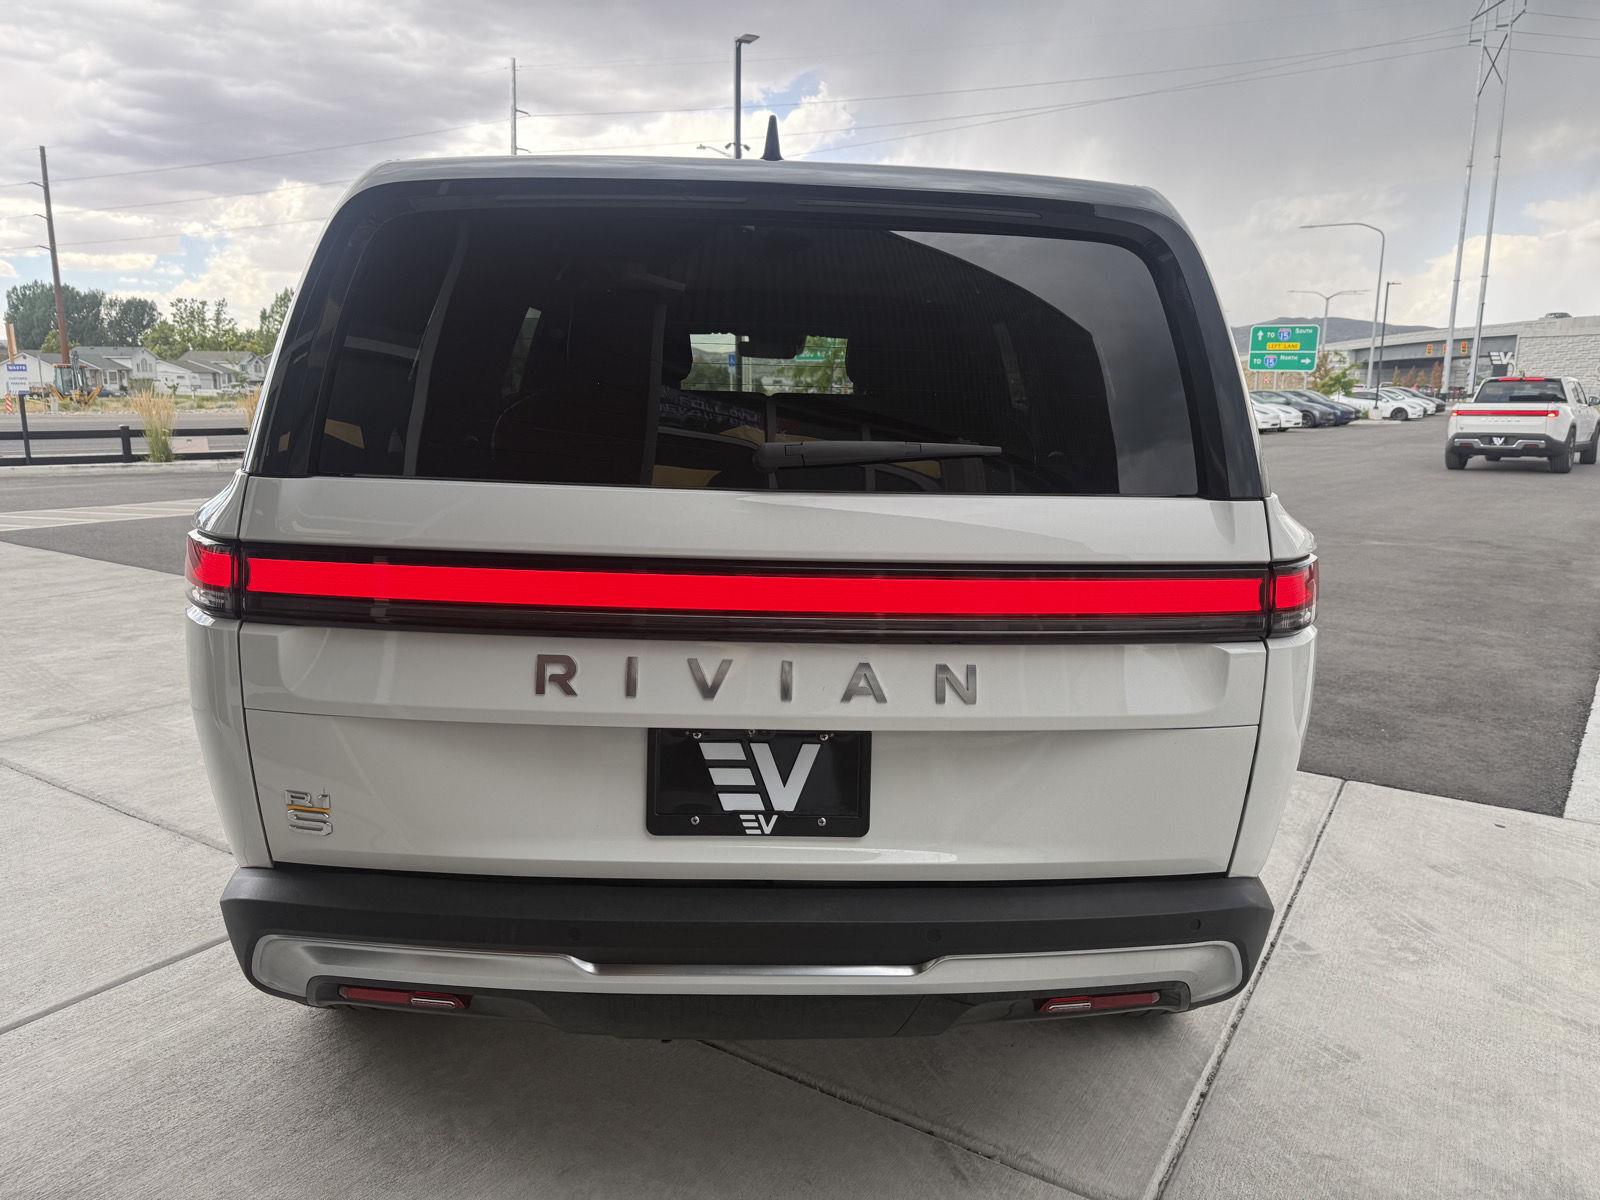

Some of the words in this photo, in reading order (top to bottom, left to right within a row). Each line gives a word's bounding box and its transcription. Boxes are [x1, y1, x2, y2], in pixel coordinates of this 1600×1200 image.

[1280, 332, 1289, 340] 15
[535, 654, 978, 705] RIVIAN
[699, 742, 822, 812] EV
[739, 814, 779, 835] EV
